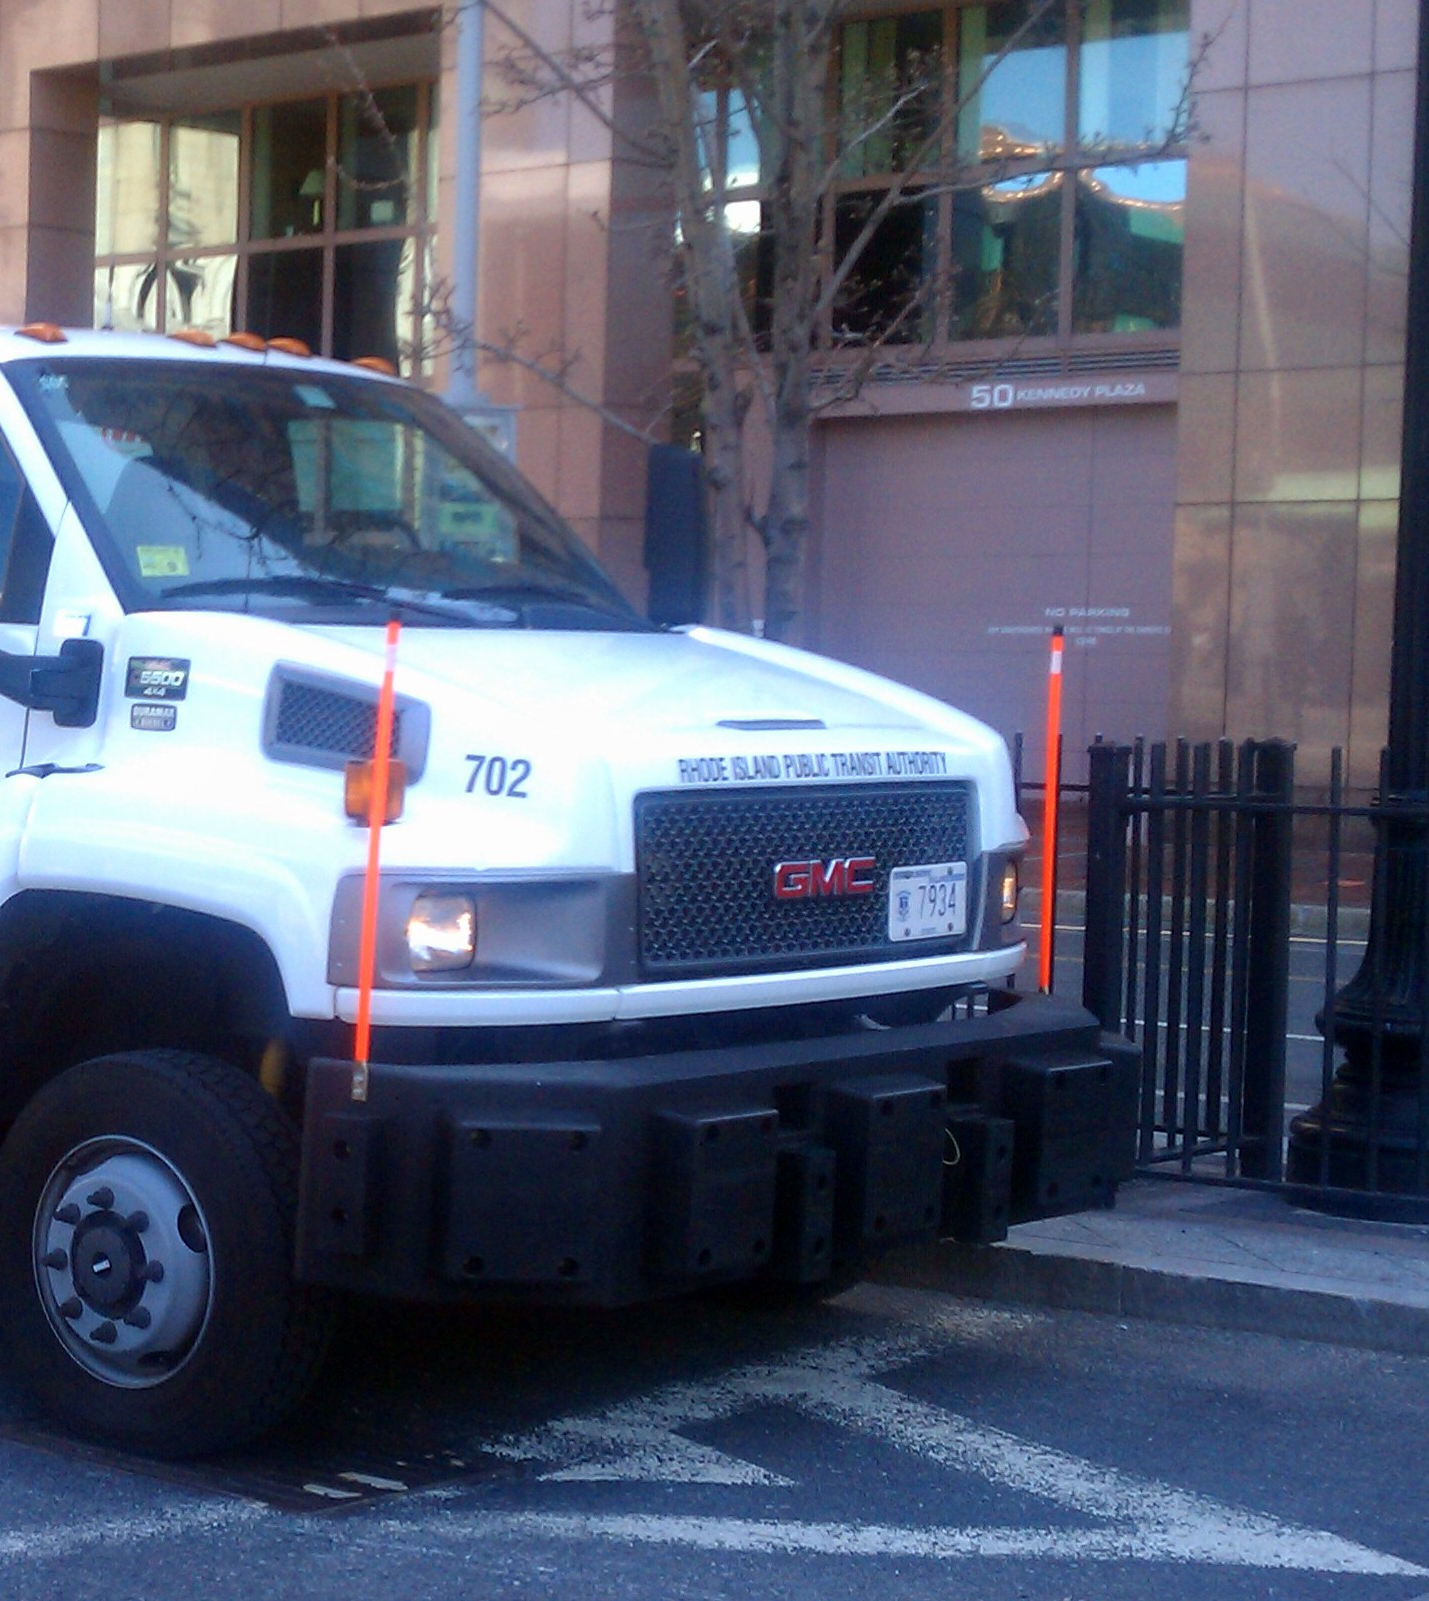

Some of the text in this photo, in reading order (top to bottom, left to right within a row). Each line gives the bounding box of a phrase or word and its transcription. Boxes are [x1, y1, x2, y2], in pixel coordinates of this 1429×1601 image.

[971, 383, 1145, 408] 50 KENNEDY PLAZA
[1045, 607, 1131, 617] NO PARKING
[465, 753, 531, 799] 702
[677, 751, 947, 783] RHODE ISLAND PUBLIC TRANSIT AUTHORITY
[774, 856, 877, 899] GMC
[918, 882, 957, 918] 7934
